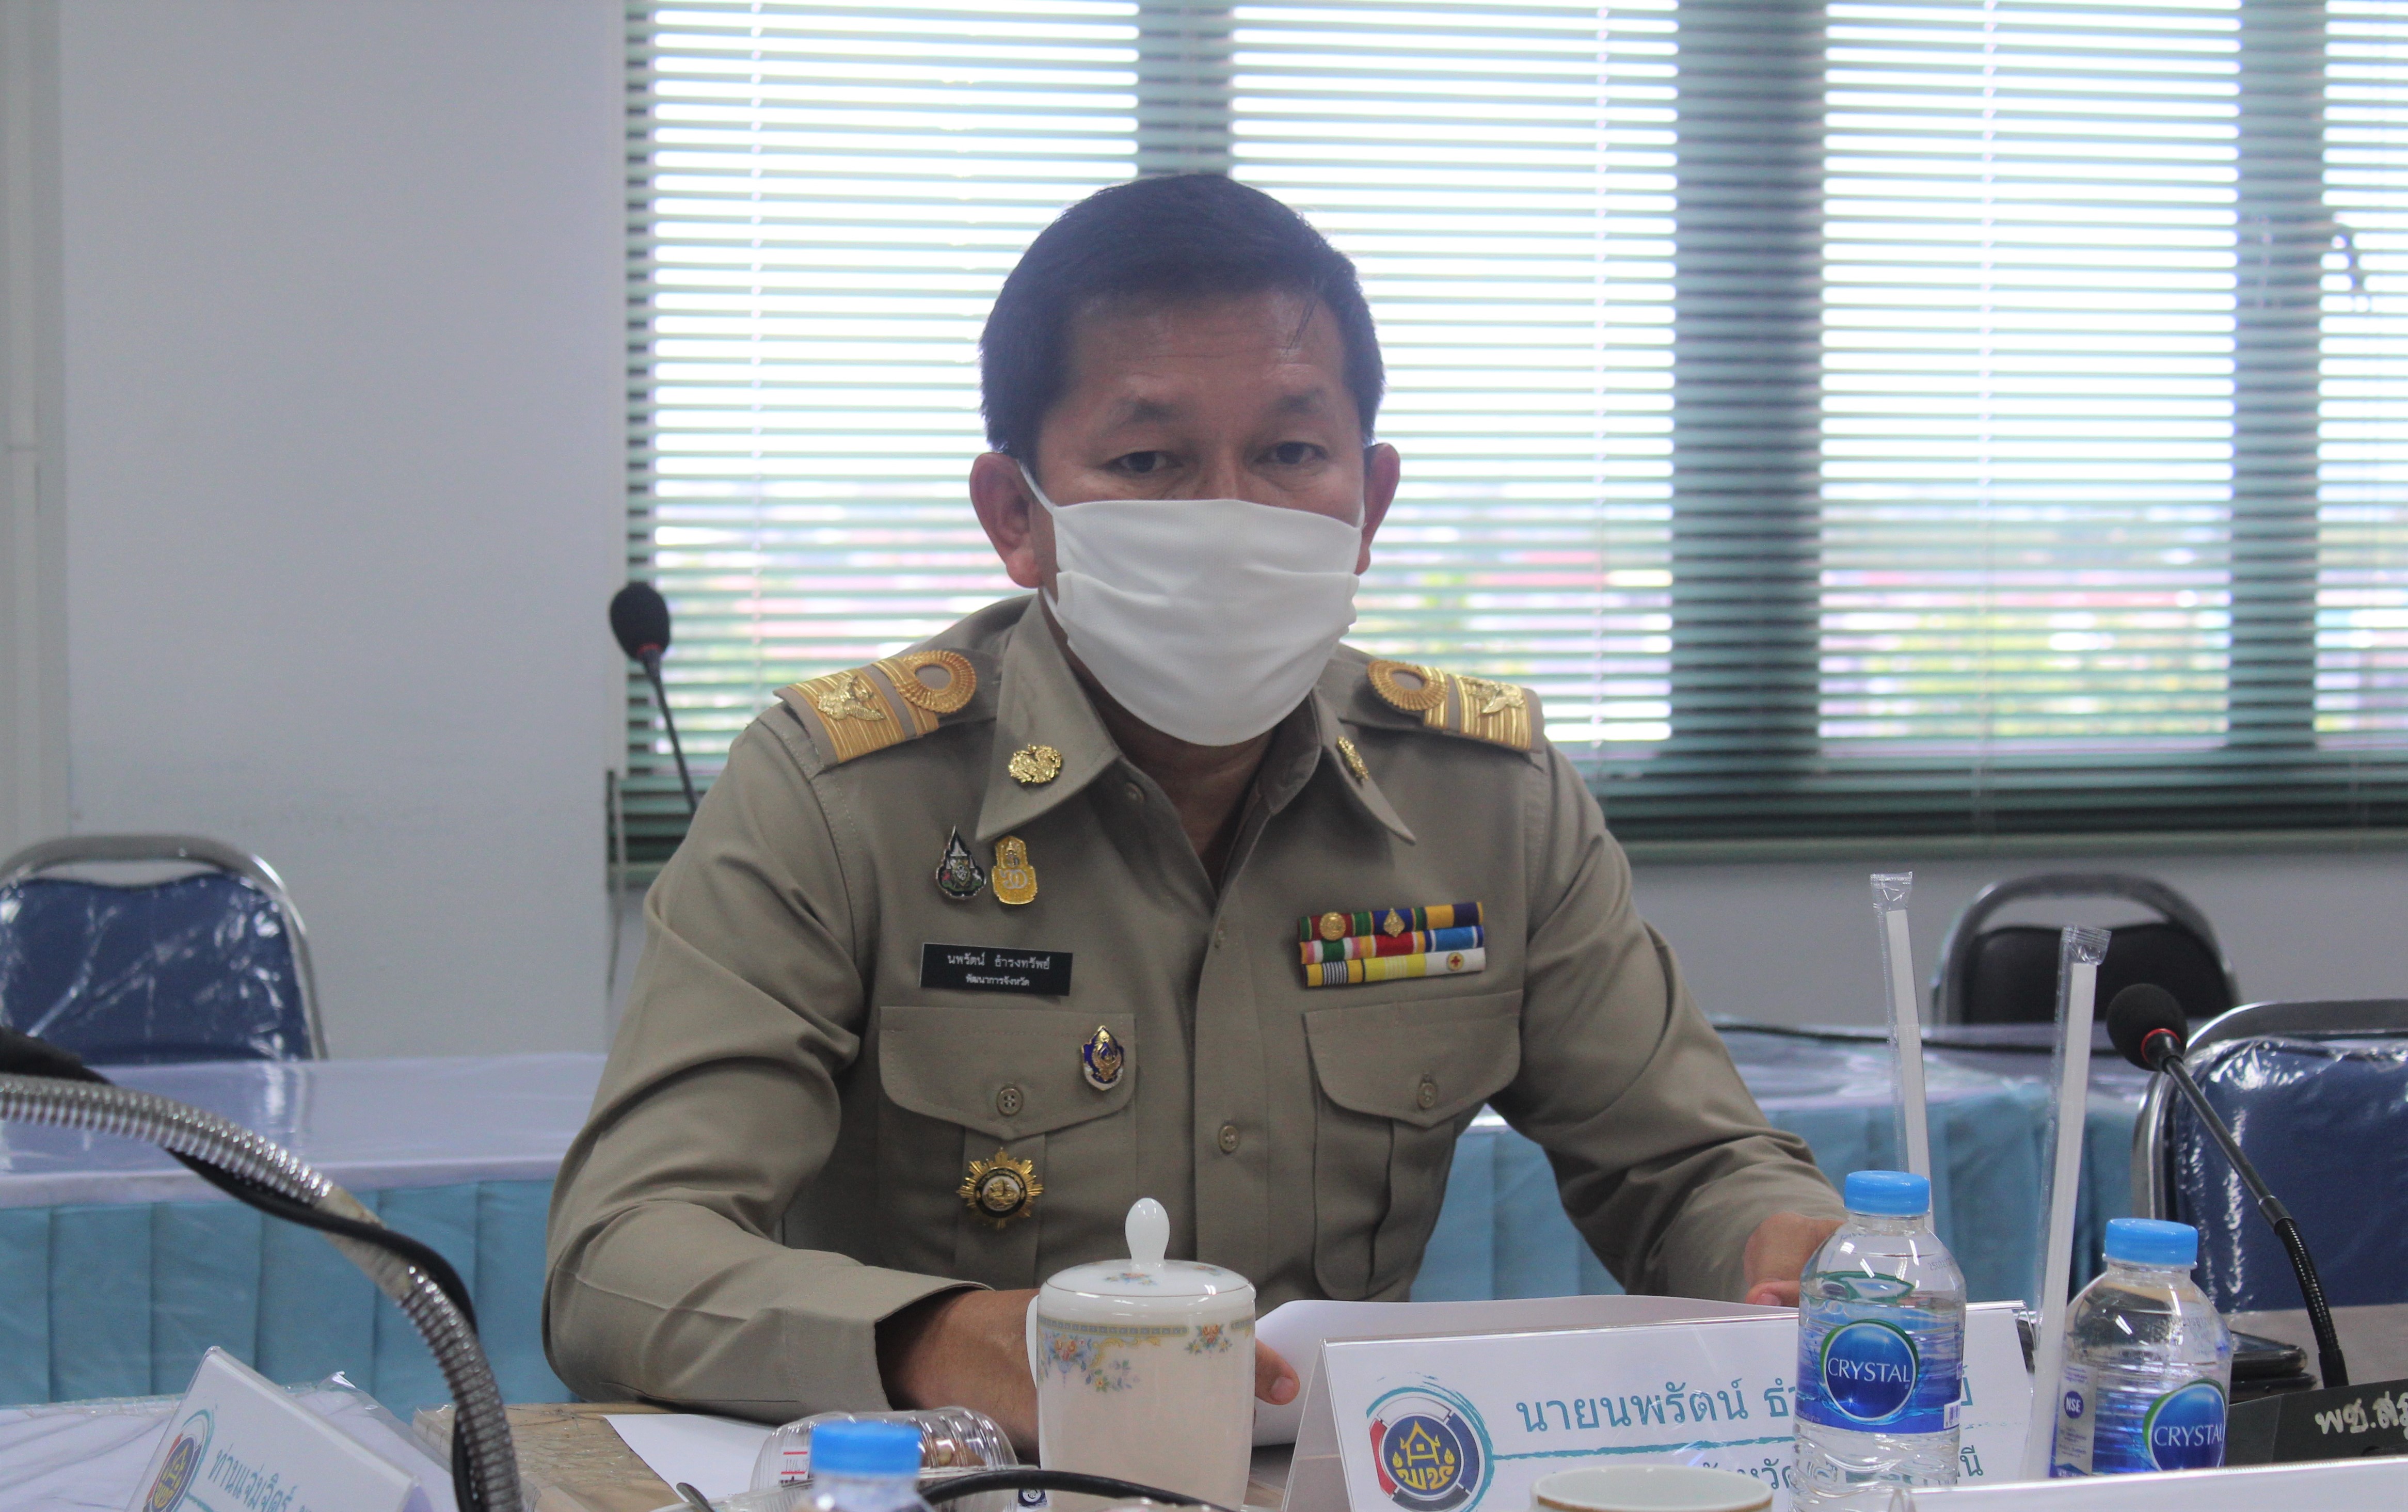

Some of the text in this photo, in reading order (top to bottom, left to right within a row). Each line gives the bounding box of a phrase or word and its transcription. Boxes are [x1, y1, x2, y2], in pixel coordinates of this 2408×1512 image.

[947, 952, 1050, 969] นพรัตน์ ธำรงทรัพย์
[1828, 1358, 1910, 1382] CRYSTAL
[1516, 1378, 1749, 1433] นายนพรัตน์
[2154, 1423, 2223, 1447] CRYSTAL
